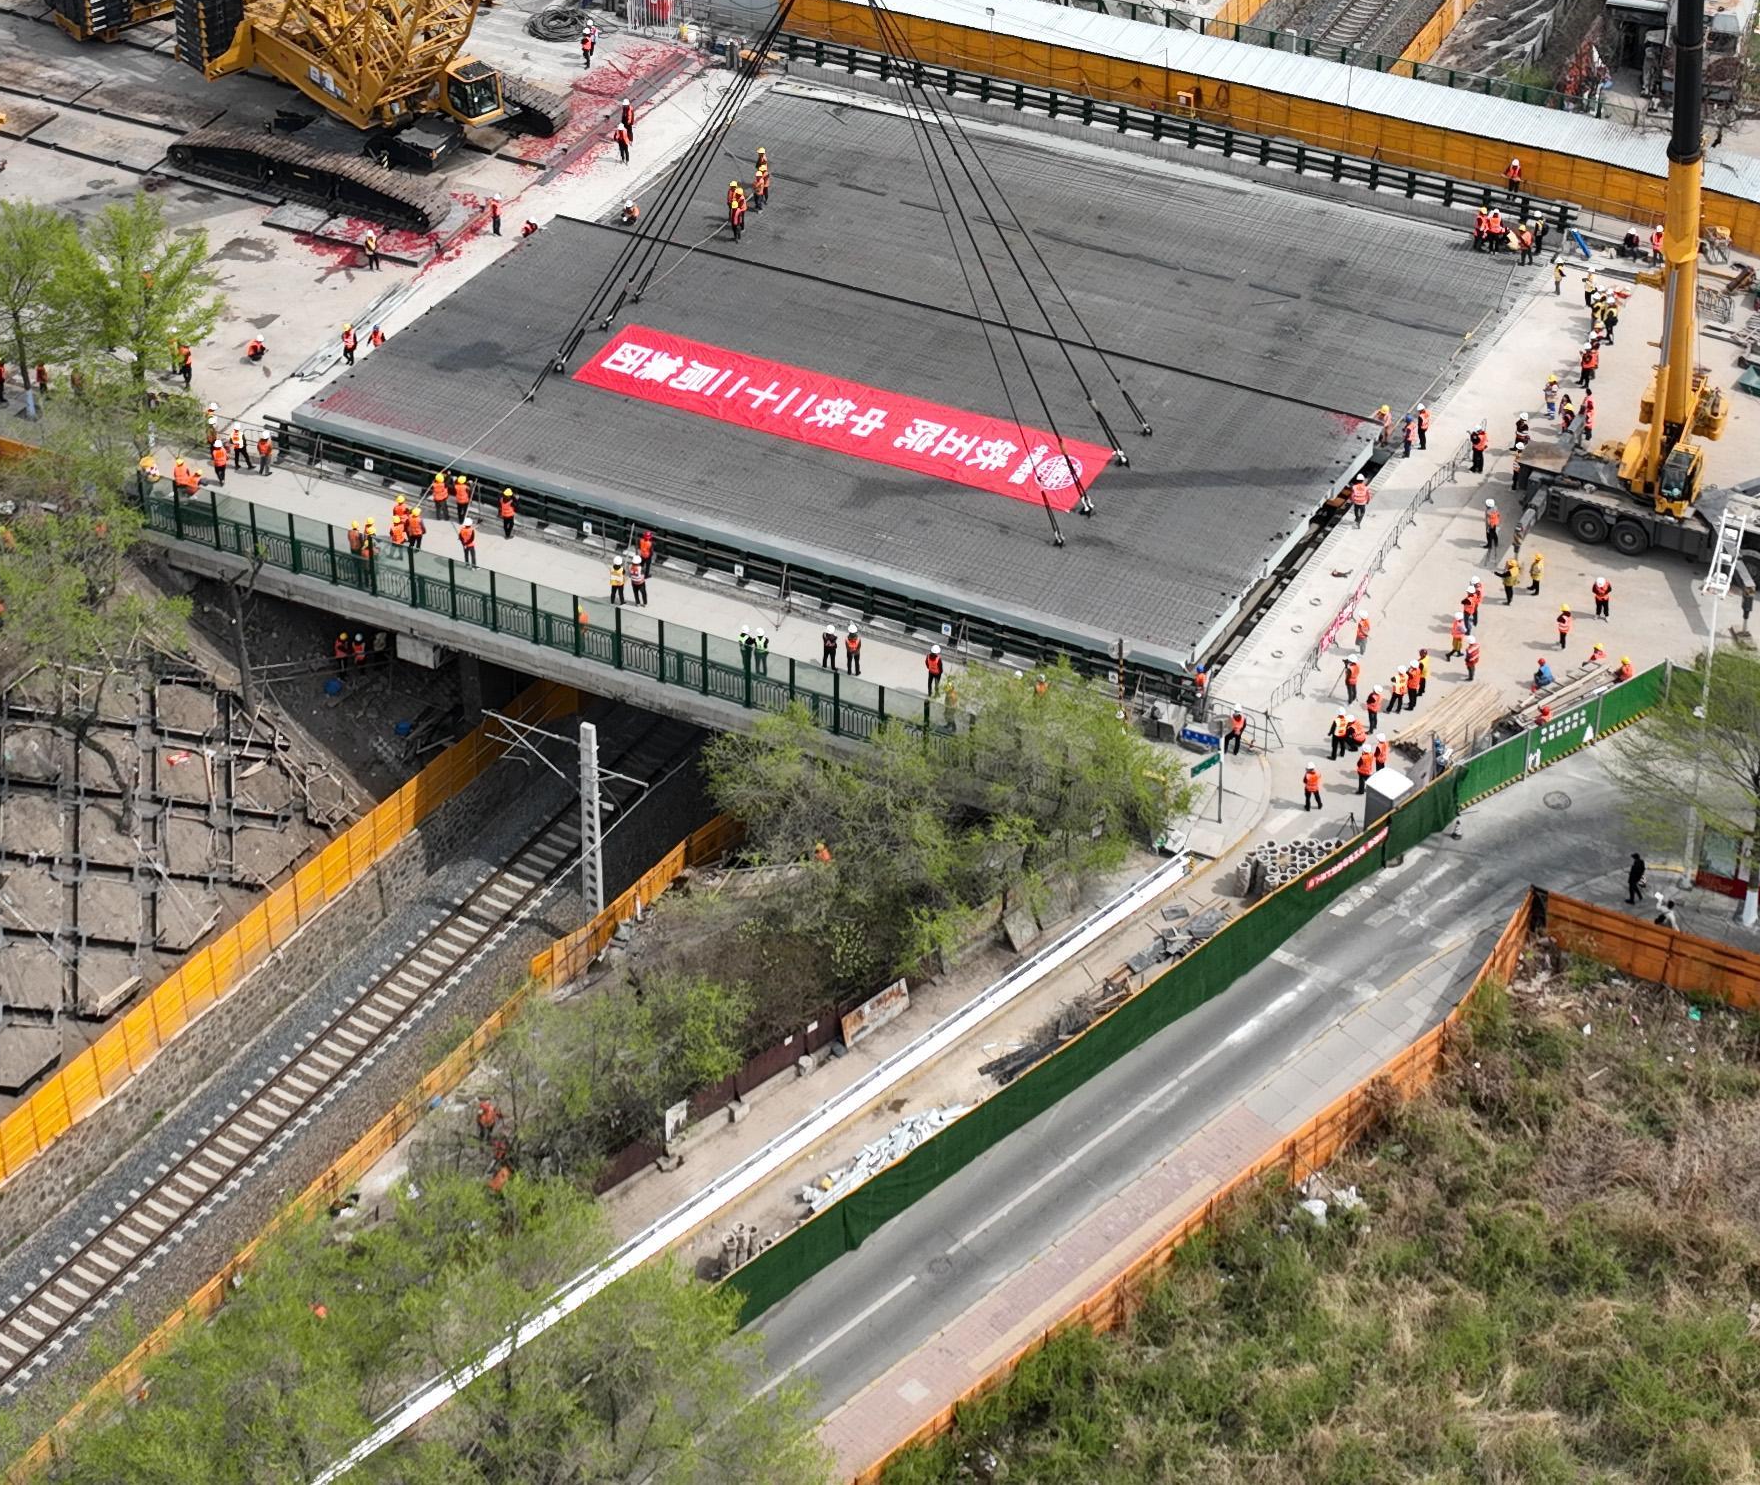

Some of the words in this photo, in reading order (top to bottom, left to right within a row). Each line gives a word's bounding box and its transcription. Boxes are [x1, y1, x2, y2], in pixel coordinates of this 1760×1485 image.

[600, 341, 887, 439] 中铁二十二局集团
[893, 417, 1020, 473] 铁五院
